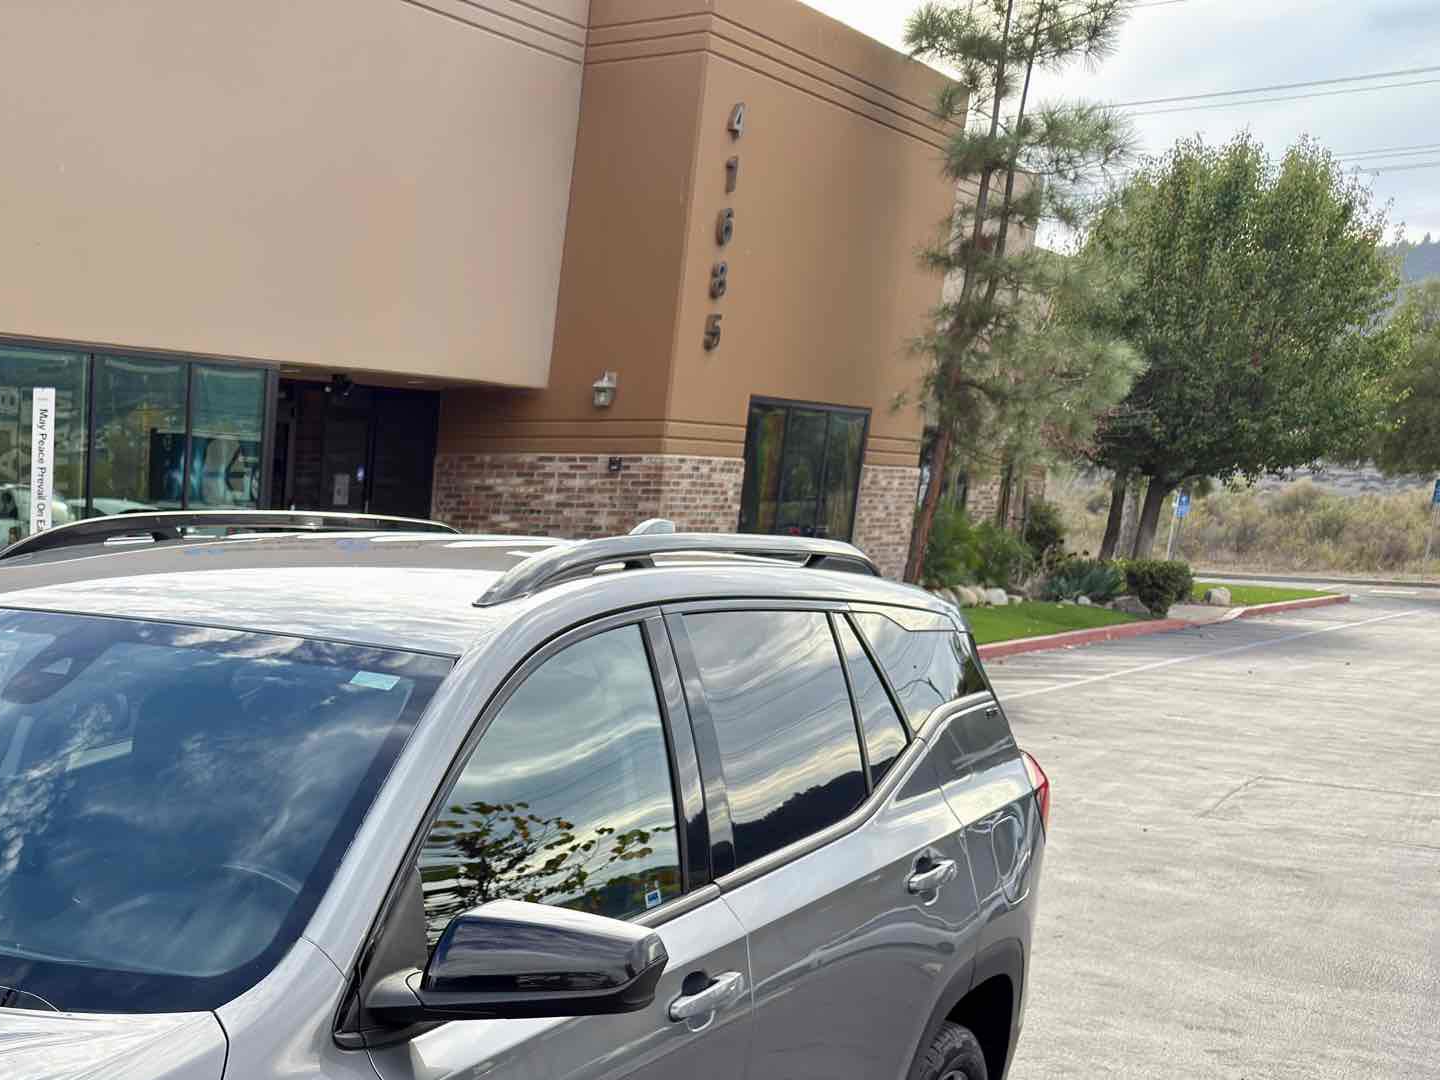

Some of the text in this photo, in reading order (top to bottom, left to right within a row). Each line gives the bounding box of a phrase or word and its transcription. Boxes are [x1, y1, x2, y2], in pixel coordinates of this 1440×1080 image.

[703, 102, 745, 351] 41685
[38, 408, 49, 431] May
[38, 433, 48, 464] Peace
[36, 466, 47, 501] Prevail
[36, 503, 46, 518] On
